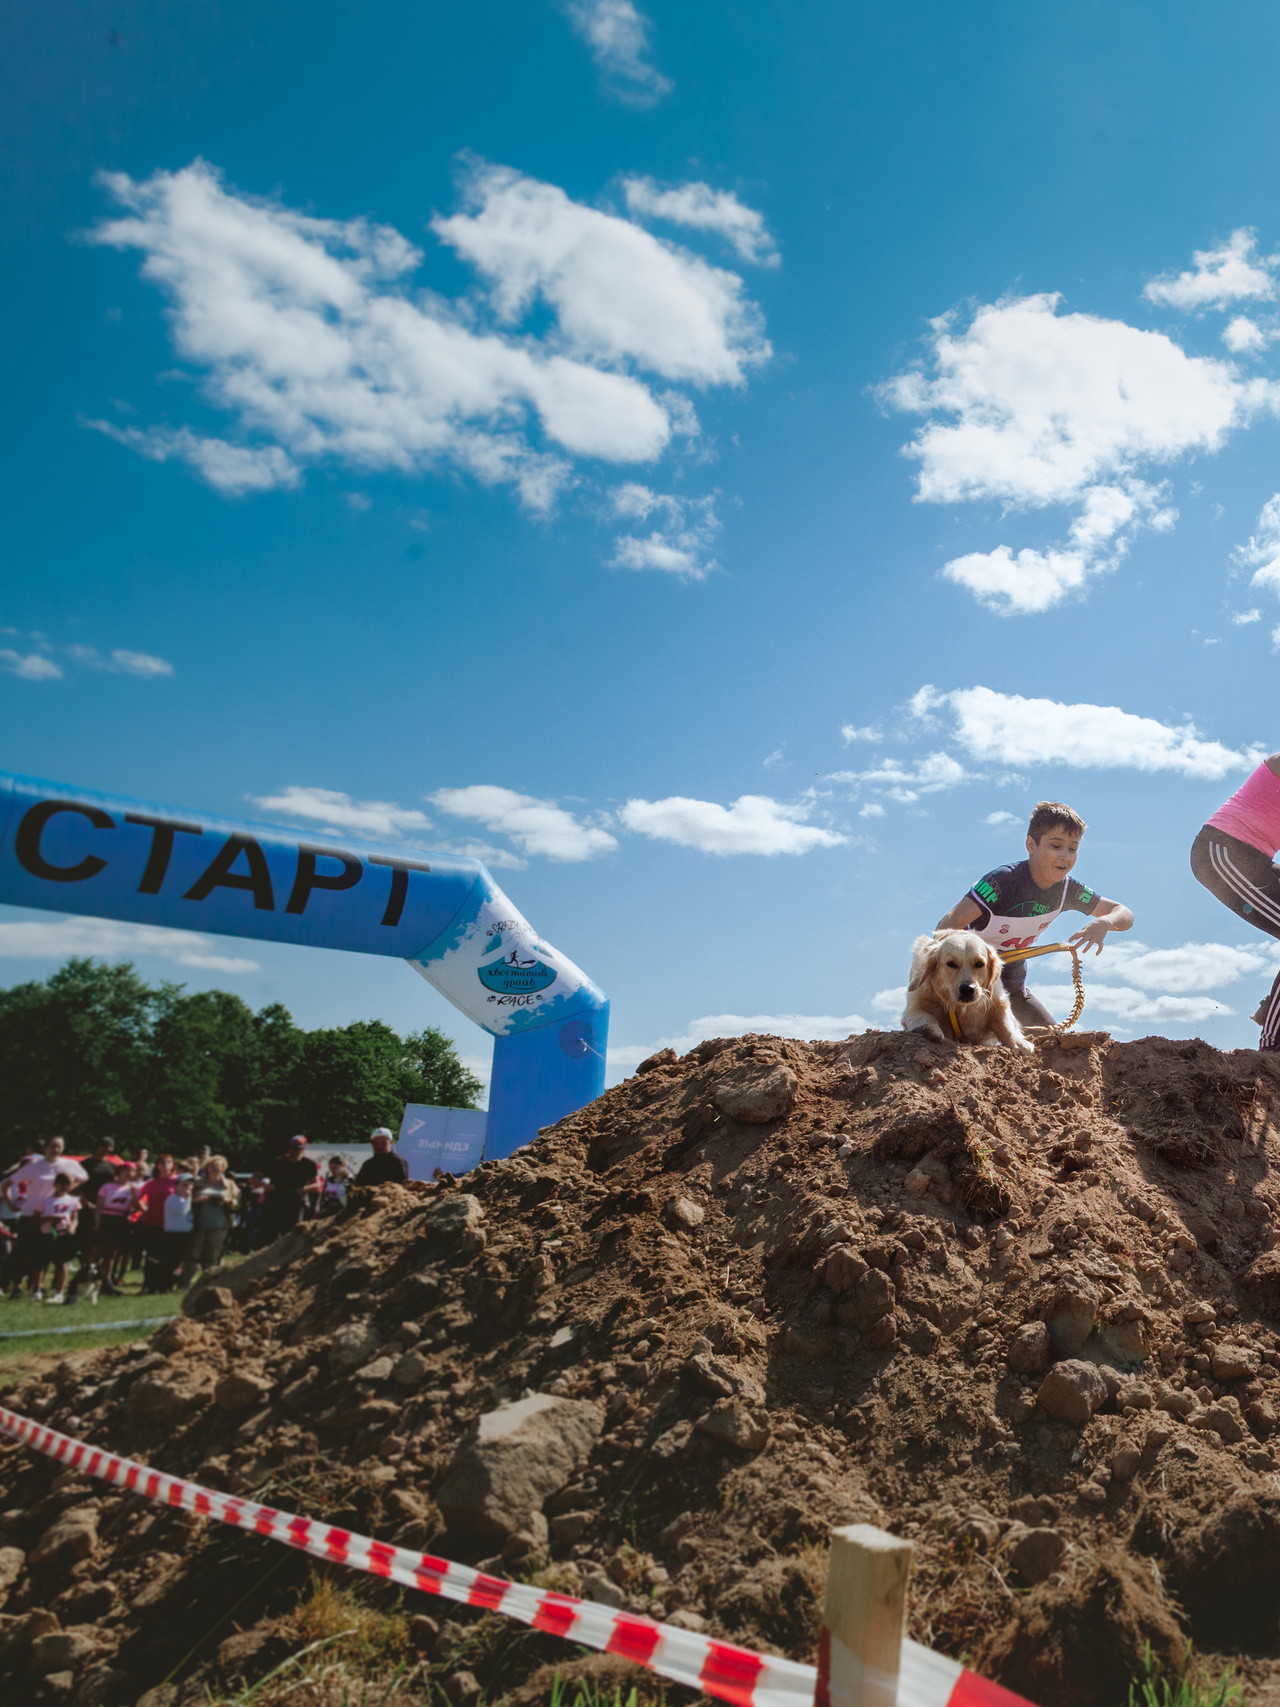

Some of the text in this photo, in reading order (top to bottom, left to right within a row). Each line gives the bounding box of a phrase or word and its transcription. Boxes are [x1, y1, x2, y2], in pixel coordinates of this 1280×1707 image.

[14, 798, 431, 927] СТАРТ
[503, 978, 536, 990] драйв
[498, 995, 535, 1007] RACE
